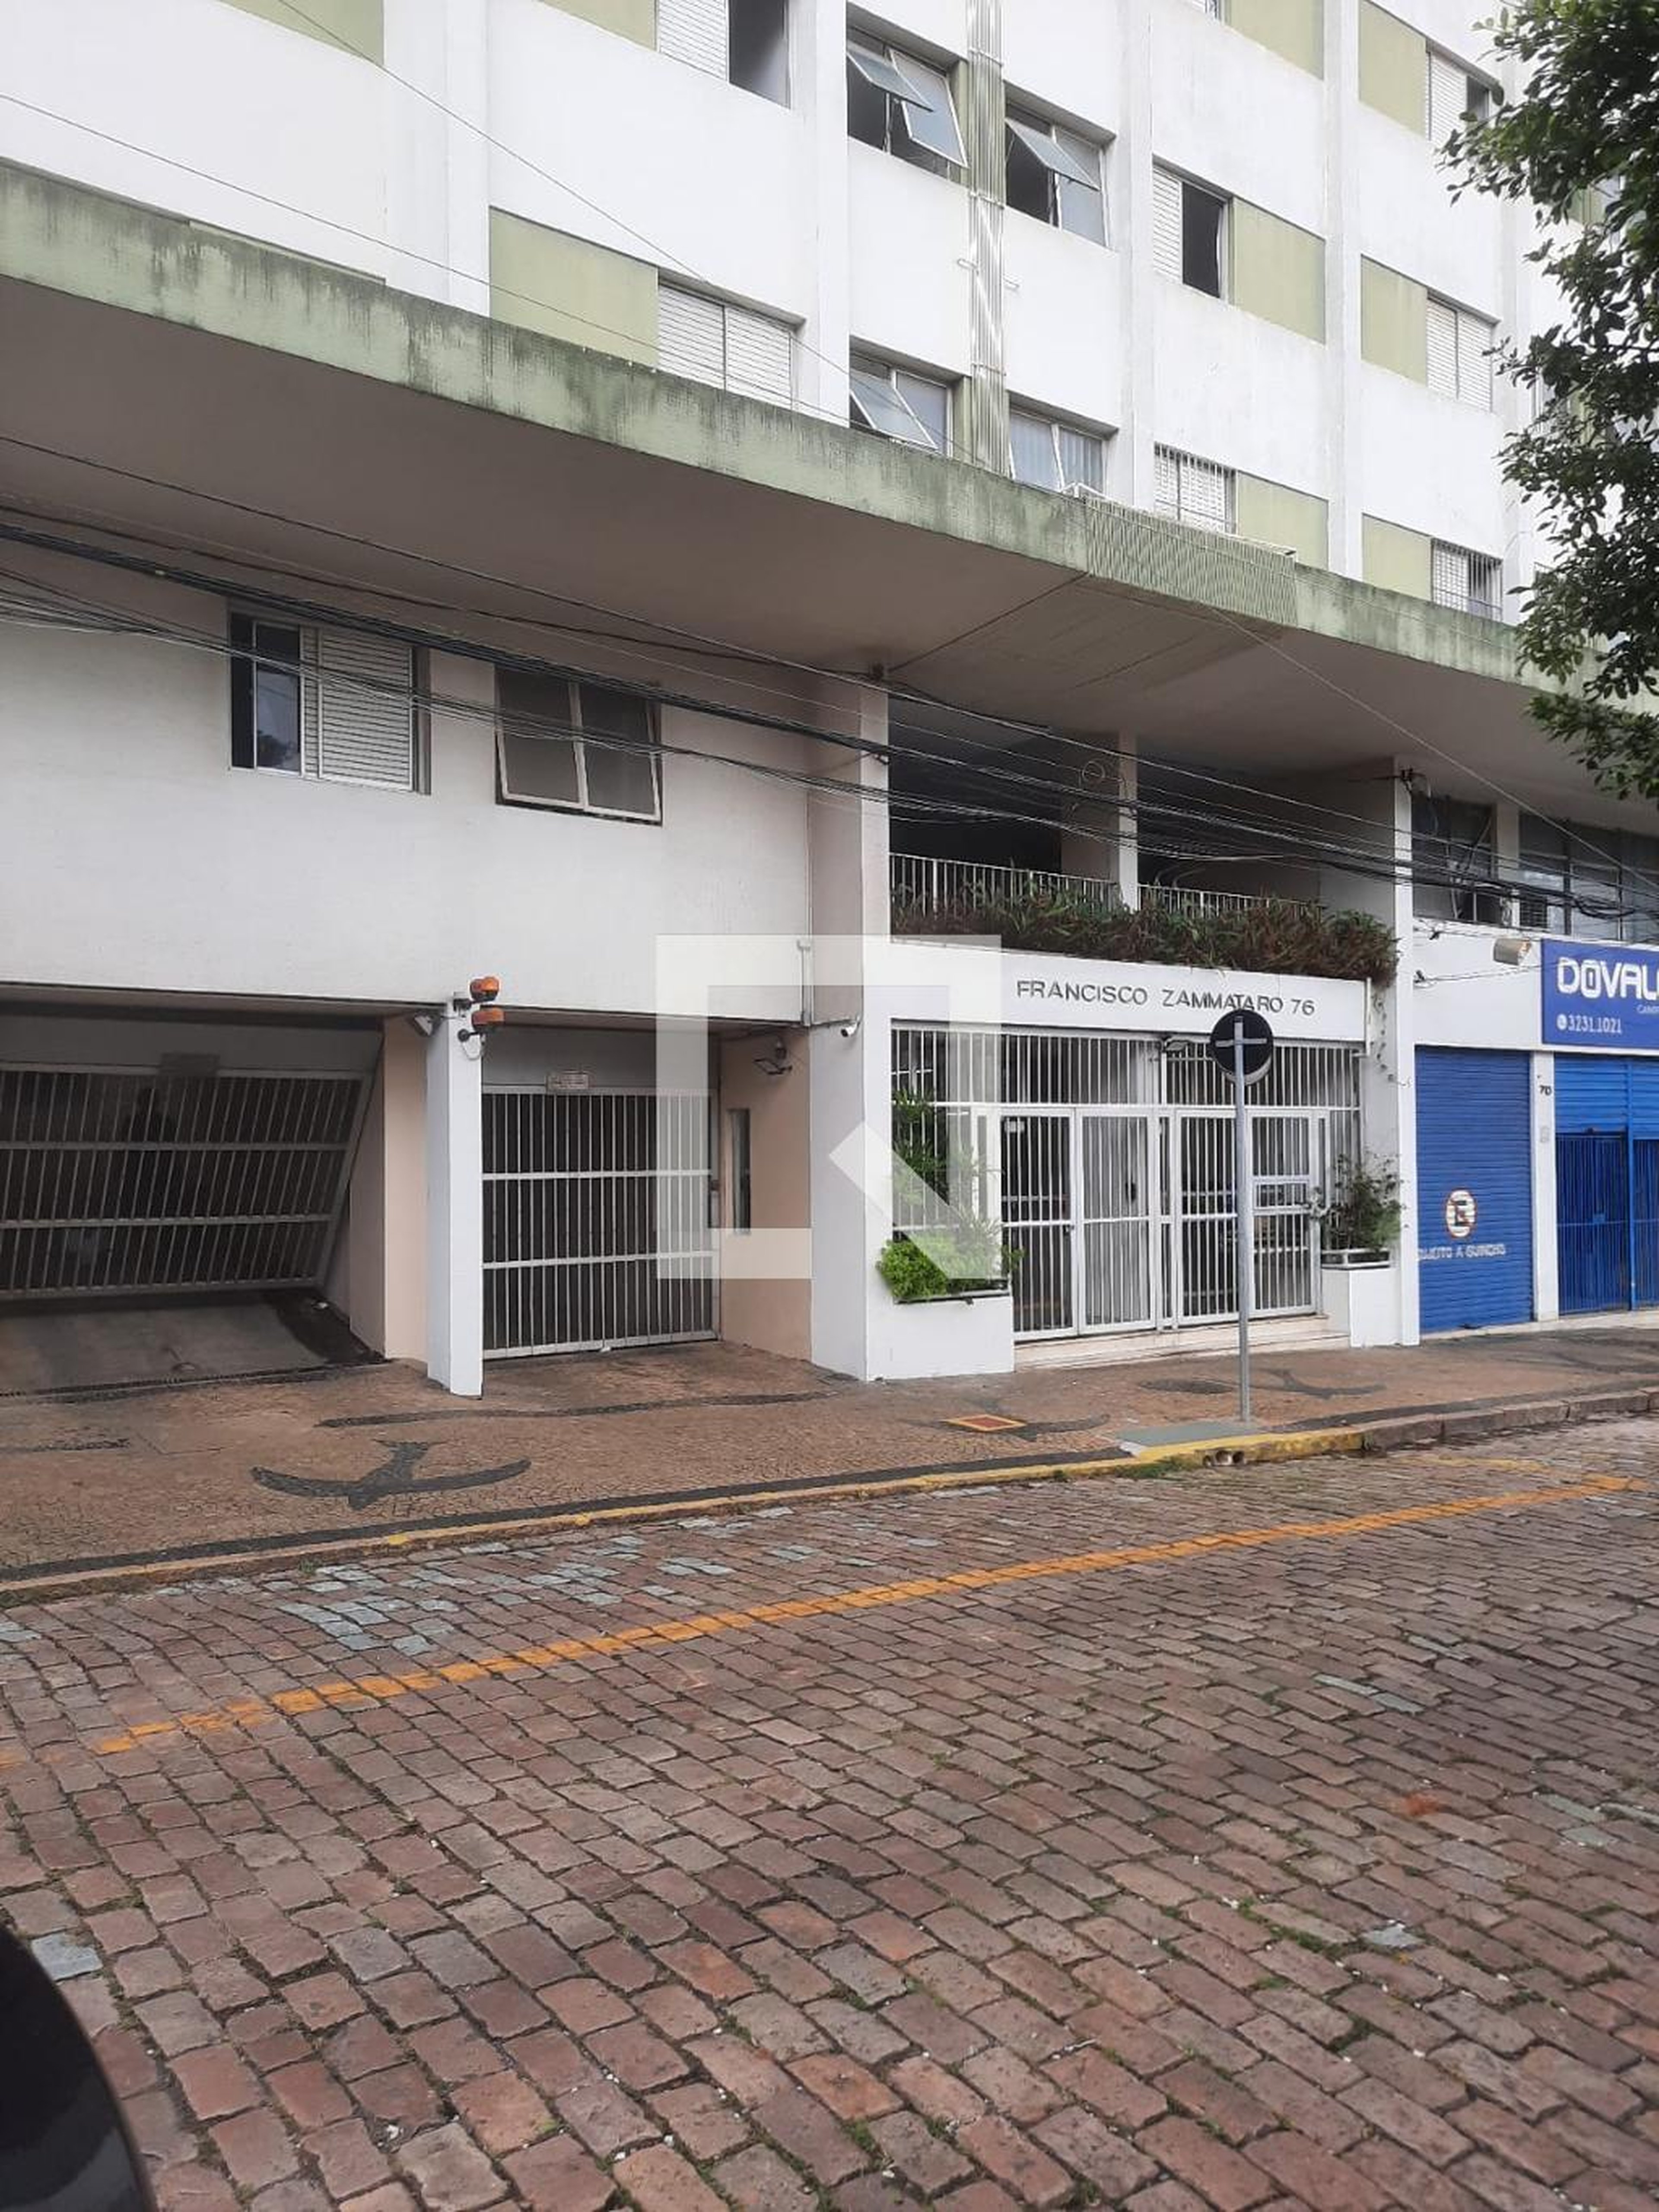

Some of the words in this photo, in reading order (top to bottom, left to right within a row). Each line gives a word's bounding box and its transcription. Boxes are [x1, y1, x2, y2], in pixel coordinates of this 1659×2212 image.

[1558, 957, 1659, 1000] DOVAL
[1017, 980, 1148, 1006] FRANCISCO
[1162, 989, 1284, 1013] ZAMMATARO
[1291, 999, 1315, 1015] 76
[1568, 1015, 1622, 1033] 3231.1021
[1540, 1085, 1552, 1095] 70
